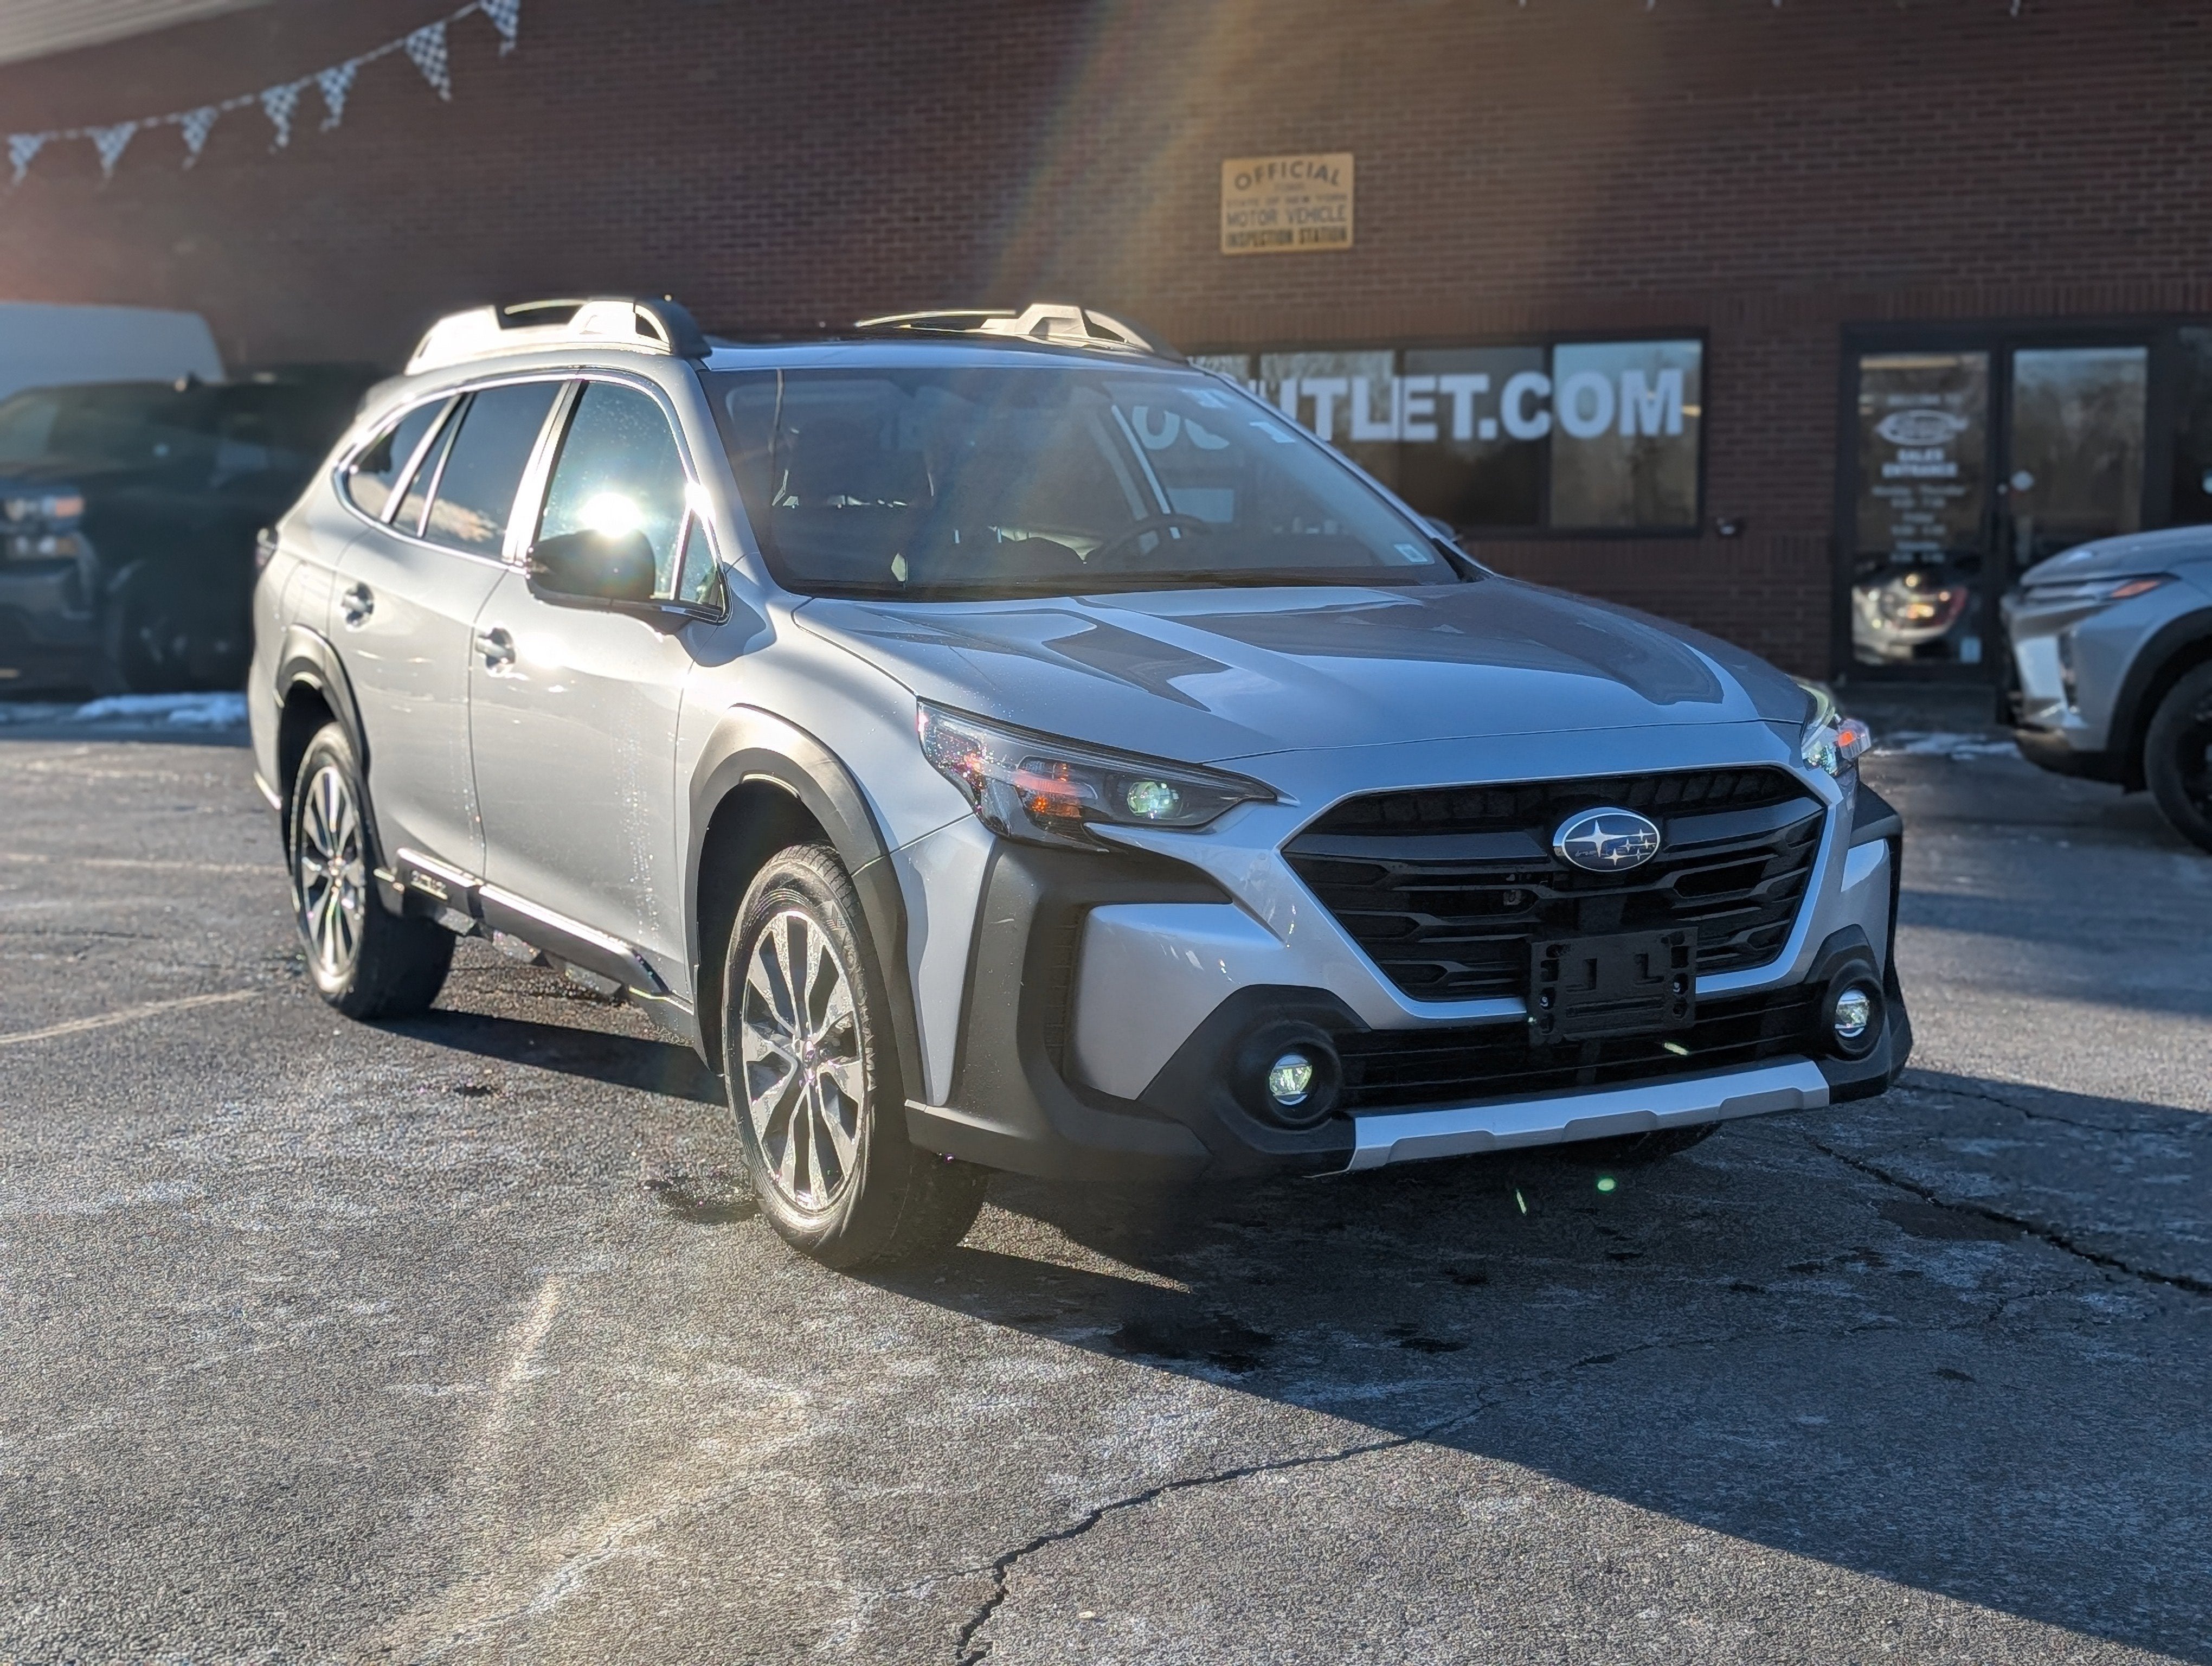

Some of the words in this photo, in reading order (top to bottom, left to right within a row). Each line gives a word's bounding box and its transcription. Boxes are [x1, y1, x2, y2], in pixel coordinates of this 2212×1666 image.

[1234, 161, 1340, 191] OFFICIAL
[1226, 208, 1278, 228] MOTOR
[1285, 203, 1348, 225] VEHICLE
[1226, 228, 1294, 248] INSPECTION
[1298, 225, 1348, 245] STATION
